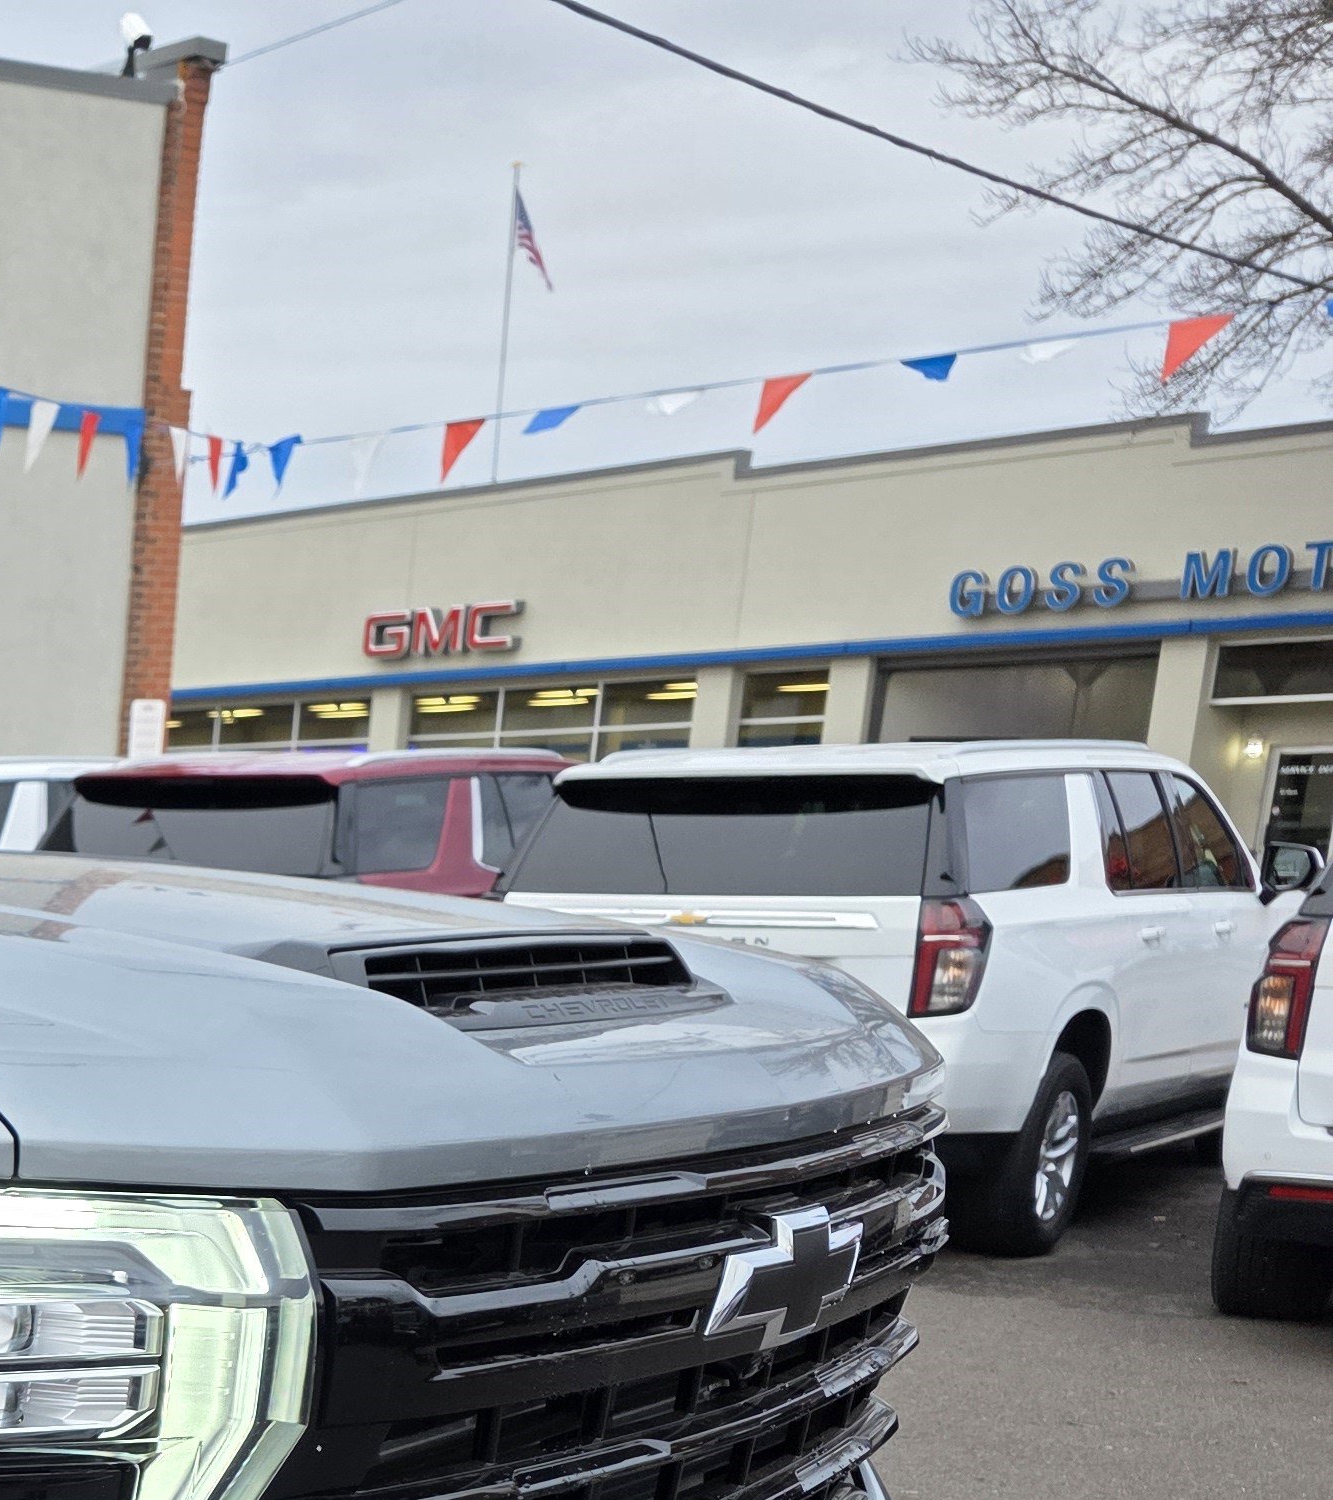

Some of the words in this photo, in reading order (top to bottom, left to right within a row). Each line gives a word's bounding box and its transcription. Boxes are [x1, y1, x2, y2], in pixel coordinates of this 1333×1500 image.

[949, 556, 1133, 619] GOSS
[362, 599, 520, 659] GMC
[521, 994, 671, 1019] CHEVROLET
